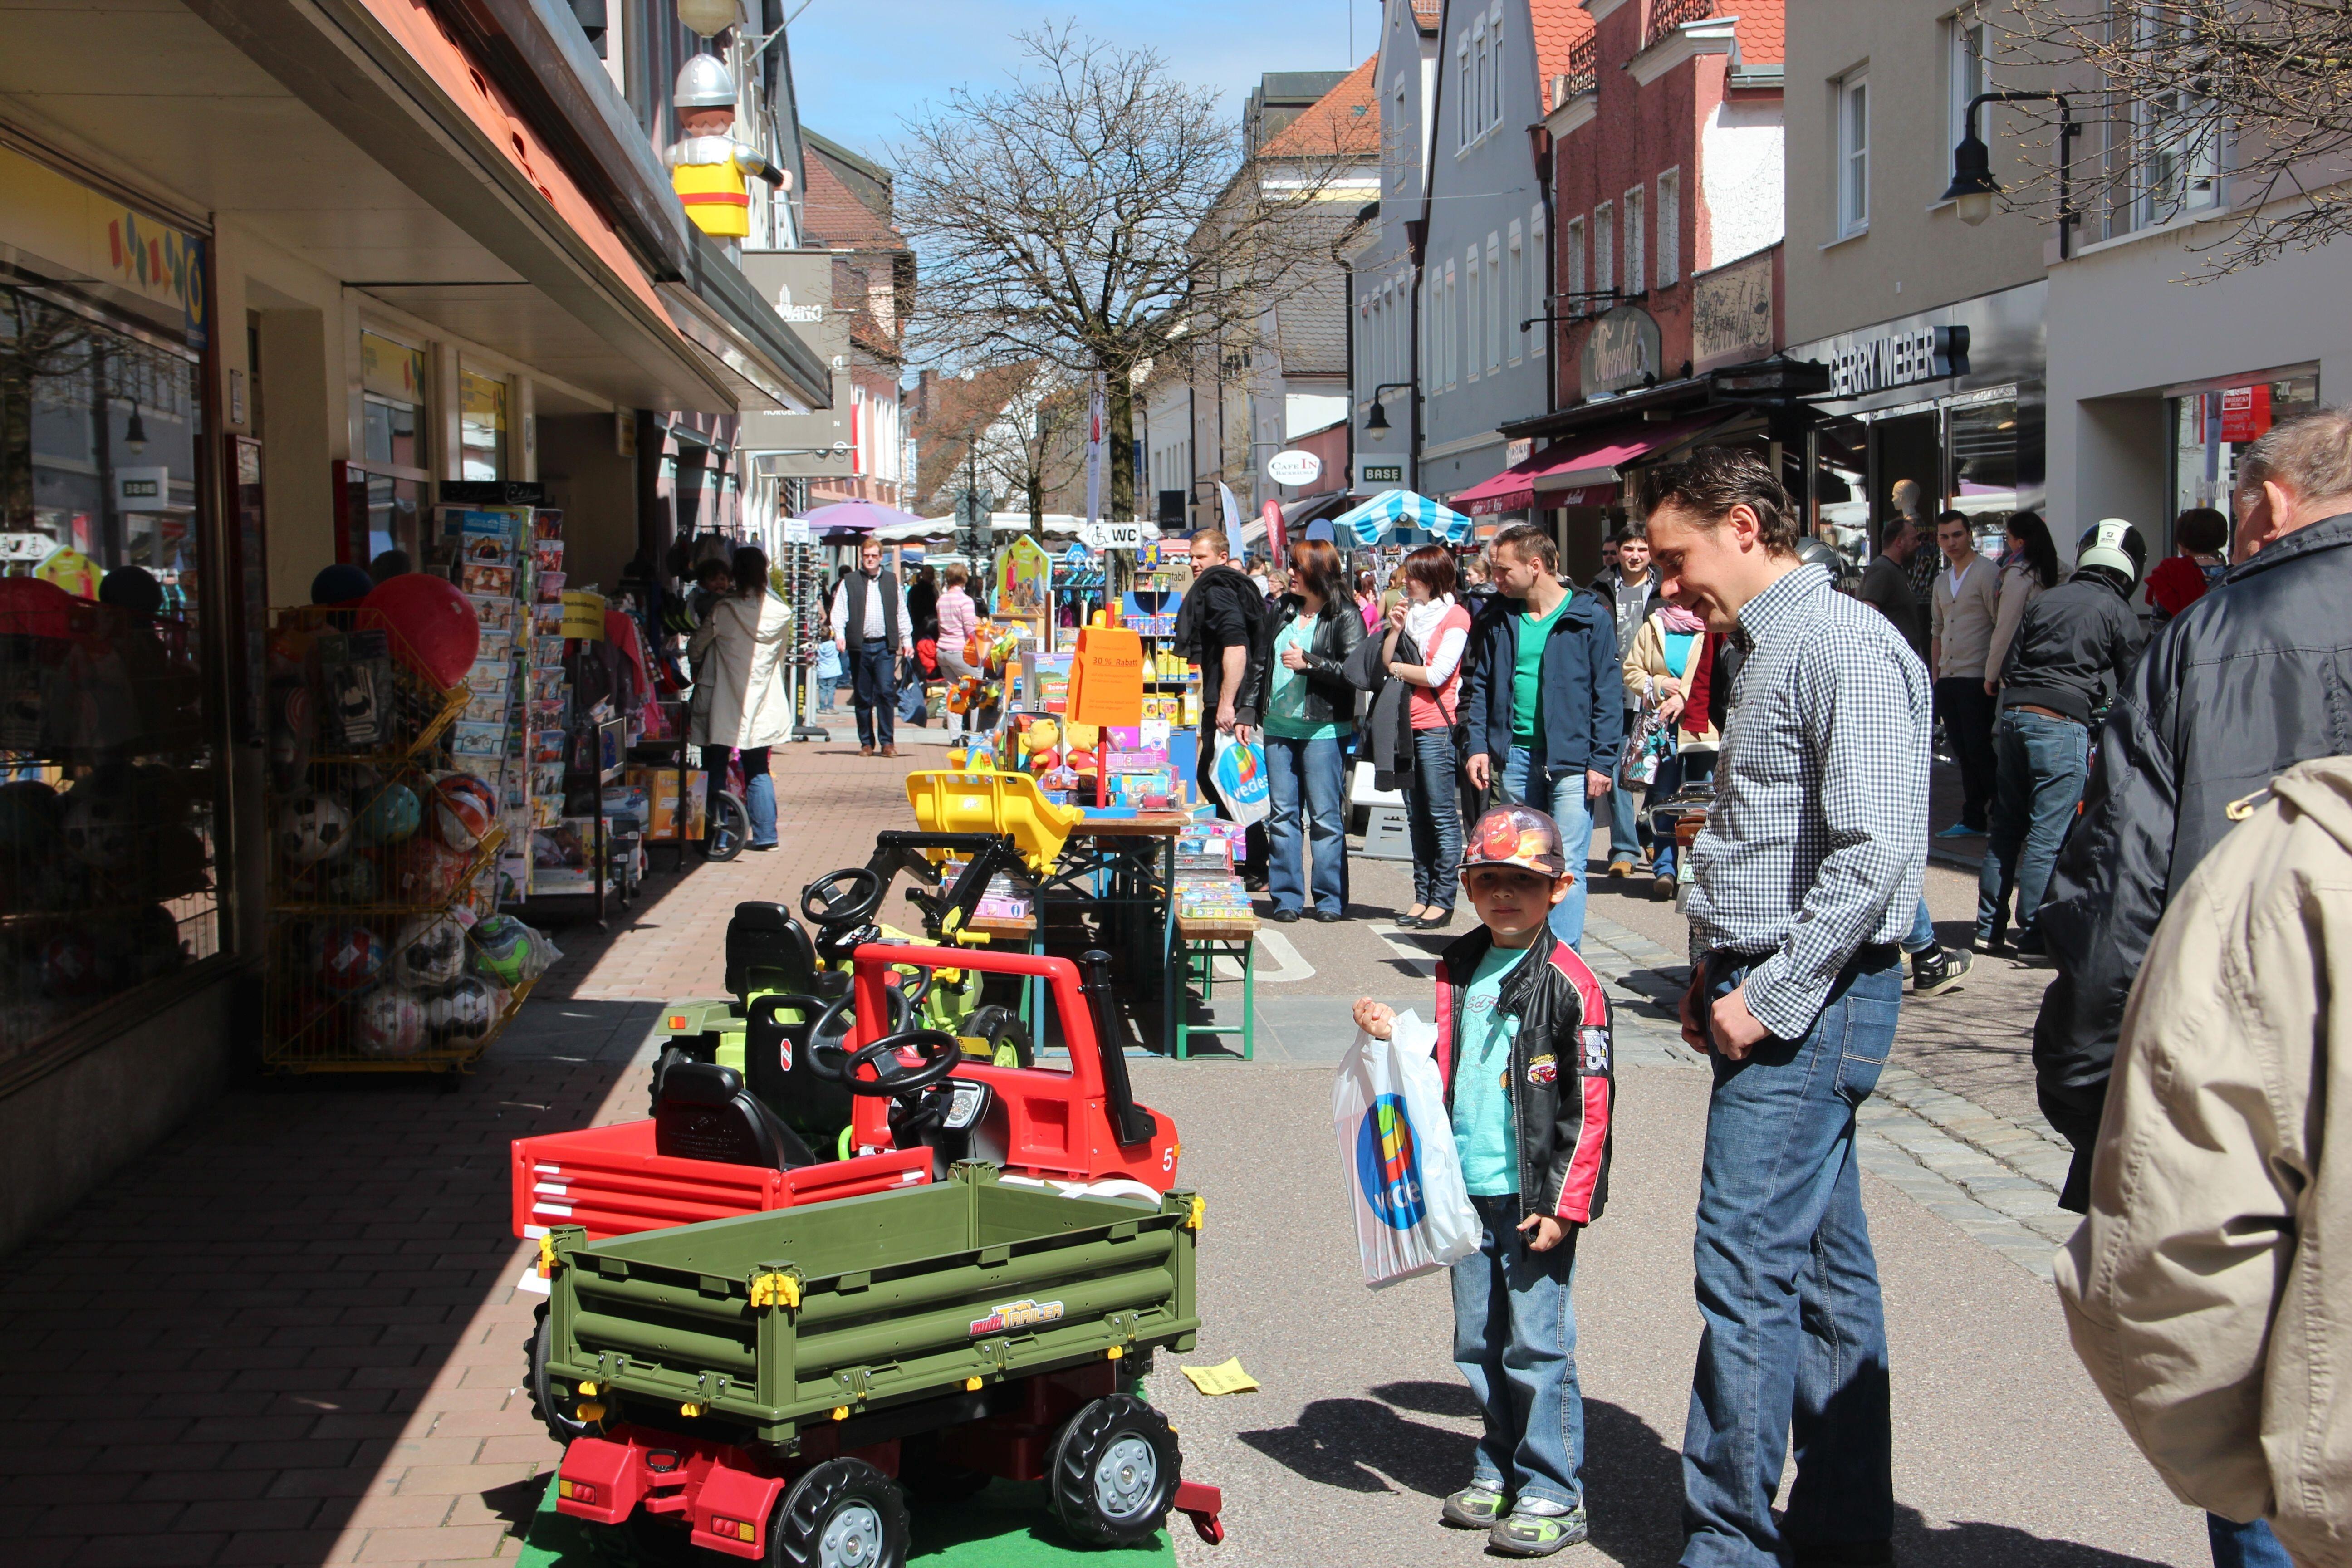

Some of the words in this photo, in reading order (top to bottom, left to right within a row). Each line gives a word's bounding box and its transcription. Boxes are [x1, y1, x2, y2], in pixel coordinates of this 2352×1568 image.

[1829, 341, 1877, 397] GERRY
[1878, 326, 1937, 387] WEBER
[1366, 469, 1399, 479] BASE
[1112, 529, 1137, 542] WC
[1171, 572, 1186, 581] tabil
[1234, 774, 1269, 799] vedes
[1162, 1147, 1173, 1172] 5
[1374, 1178, 1421, 1215] vede
[970, 1315, 1002, 1335] multi
[996, 1303, 1062, 1328] TRAILER
